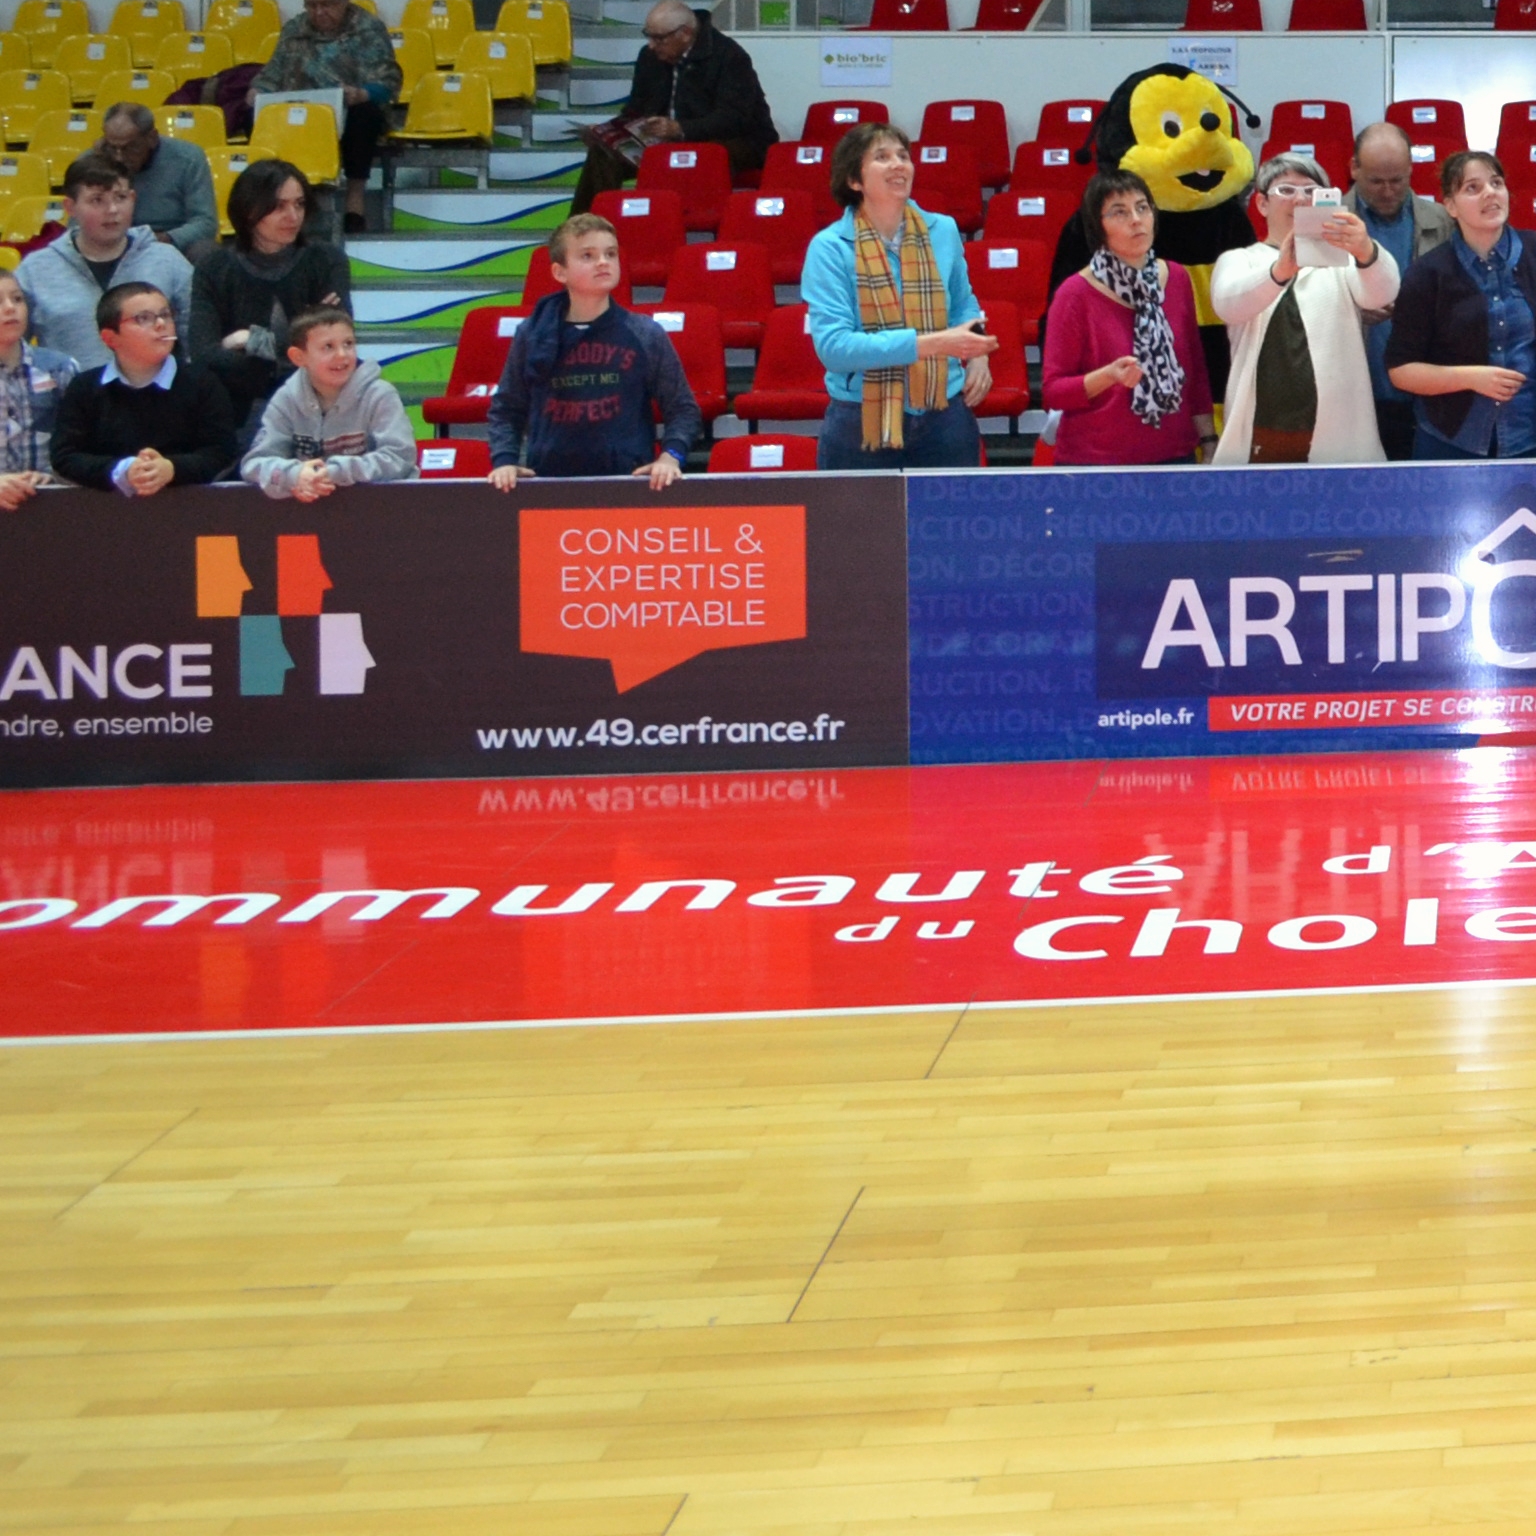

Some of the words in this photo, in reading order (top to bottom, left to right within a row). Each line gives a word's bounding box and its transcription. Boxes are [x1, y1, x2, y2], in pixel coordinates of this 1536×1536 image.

[559, 527, 723, 556] CONSEIL
[734, 523, 764, 555] &
[560, 563, 765, 592] EXPERTISE
[560, 600, 766, 629] COMPTABLE
[74, 712, 214, 735] ensemble
[1098, 707, 1195, 729] artipole.fr
[1229, 702, 1307, 722] VOTRE
[1313, 699, 1397, 722] PROJET
[1404, 699, 1433, 717] SE
[477, 714, 846, 749] www.49.cerfrance.fr
[834, 915, 975, 943] du
